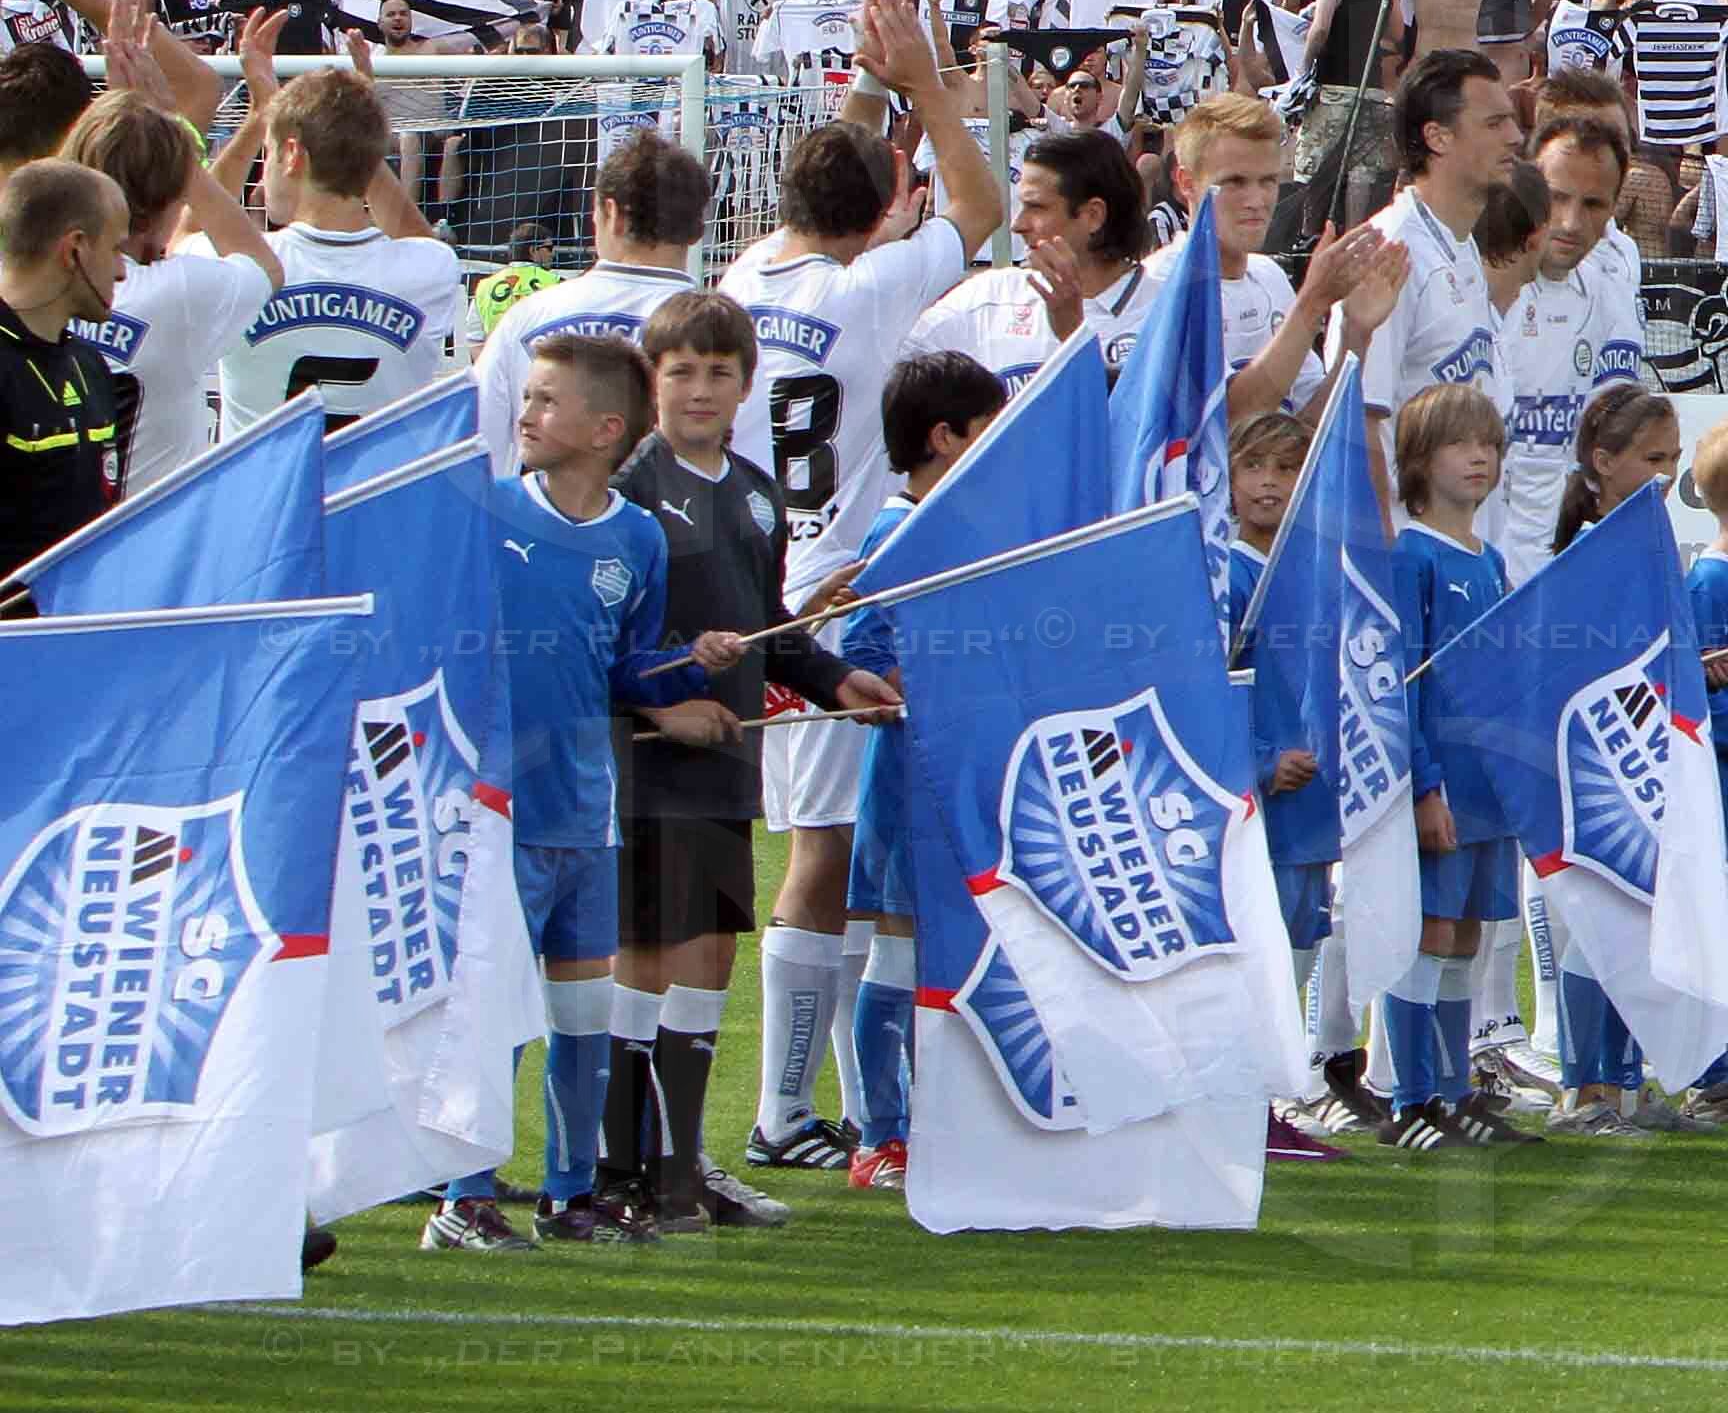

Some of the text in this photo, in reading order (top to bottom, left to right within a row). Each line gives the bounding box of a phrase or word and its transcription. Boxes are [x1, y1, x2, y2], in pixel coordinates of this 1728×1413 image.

[771, 374, 842, 510] 8
[1348, 626, 1401, 702] SC
[381, 780, 437, 998] WIENER
[1046, 732, 1157, 966] NEUSTADT
[1091, 778, 1187, 959] WIENER
[1148, 790, 1208, 869] SC
[53, 824, 128, 1112] NEUSTADT
[95, 891, 165, 1107] WIENER
[171, 915, 231, 1003] SC
[778, 993, 816, 1098] PUNTIGAMER
